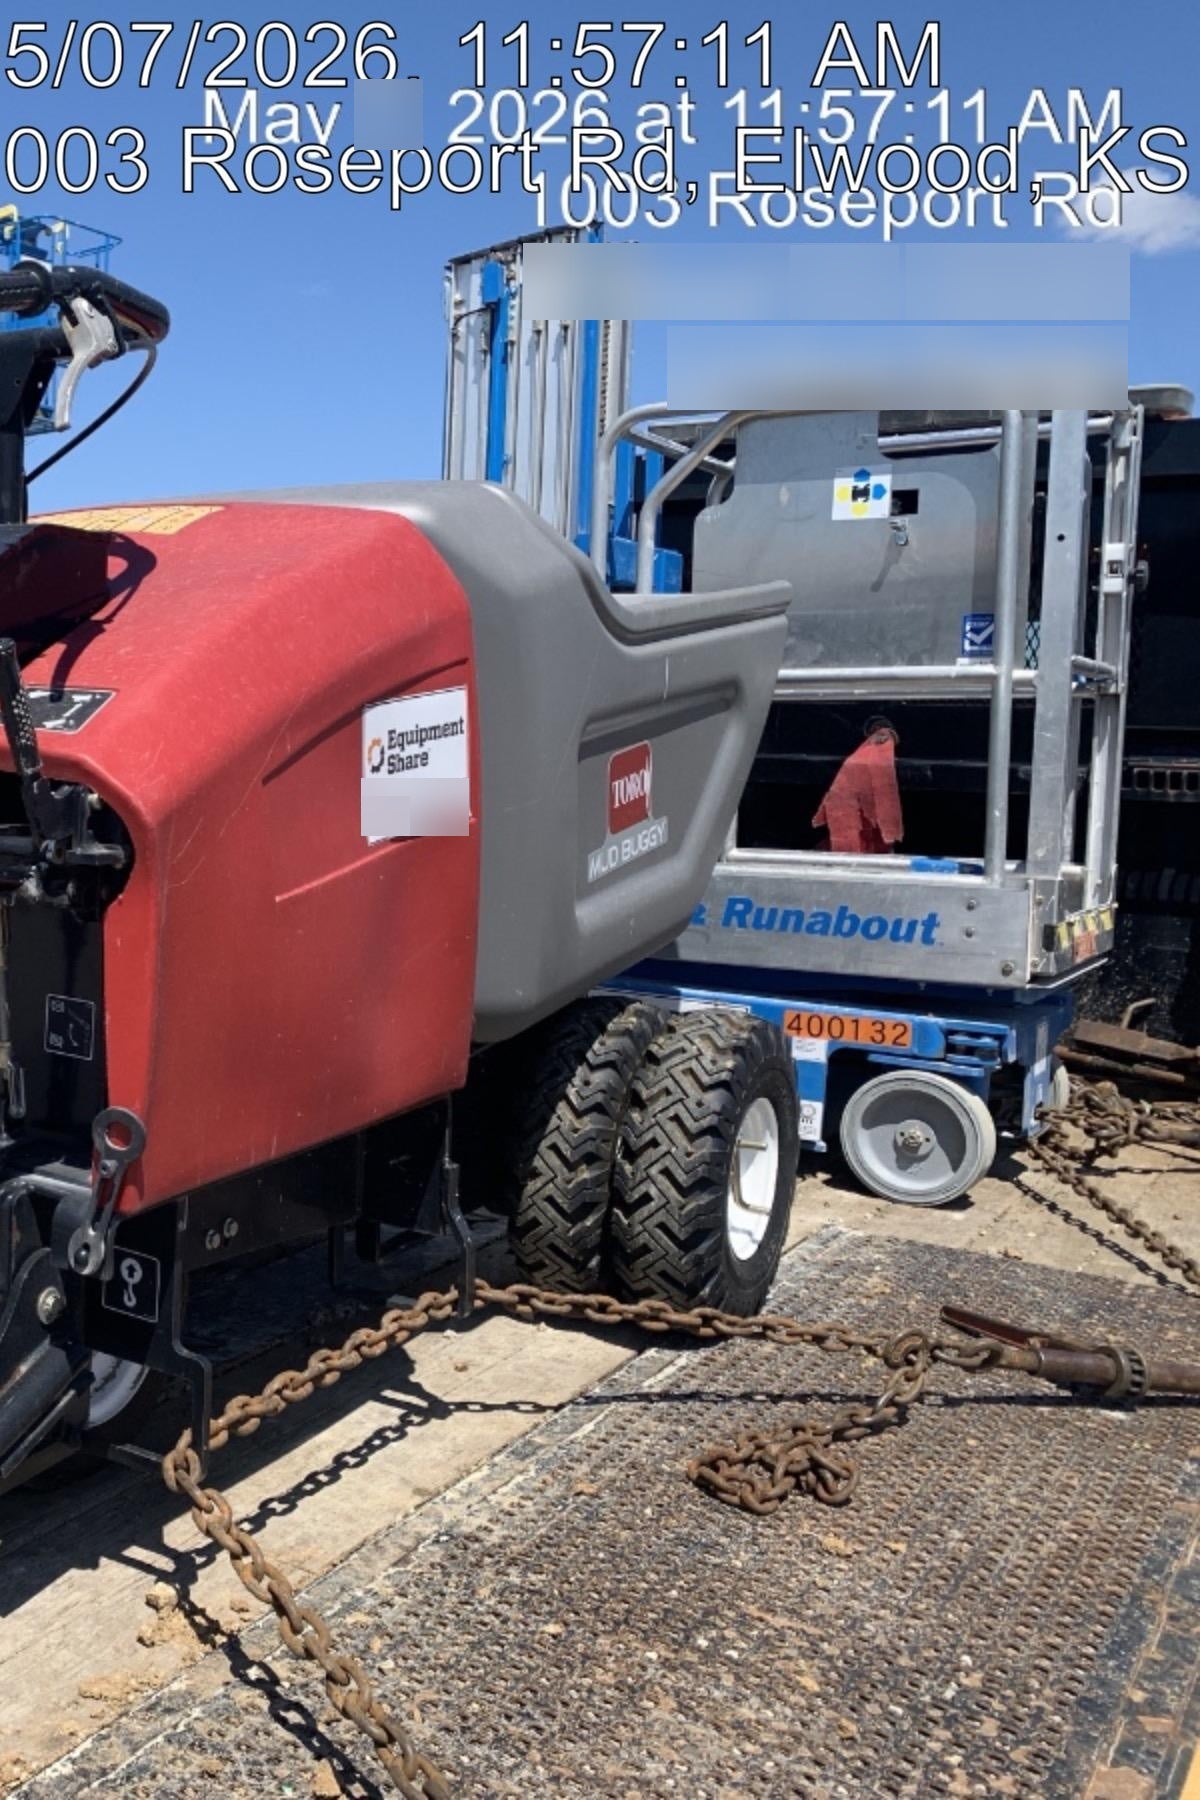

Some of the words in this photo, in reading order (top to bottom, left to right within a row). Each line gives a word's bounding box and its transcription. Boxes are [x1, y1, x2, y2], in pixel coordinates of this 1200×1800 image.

[387, 716, 465, 752] Equipment
[387, 751, 429, 775] Share
[589, 845, 619, 881] MUD
[621, 822, 666, 861] BUGGY
[721, 895, 940, 945] Runabout
[786, 1013, 909, 1047] 400132
